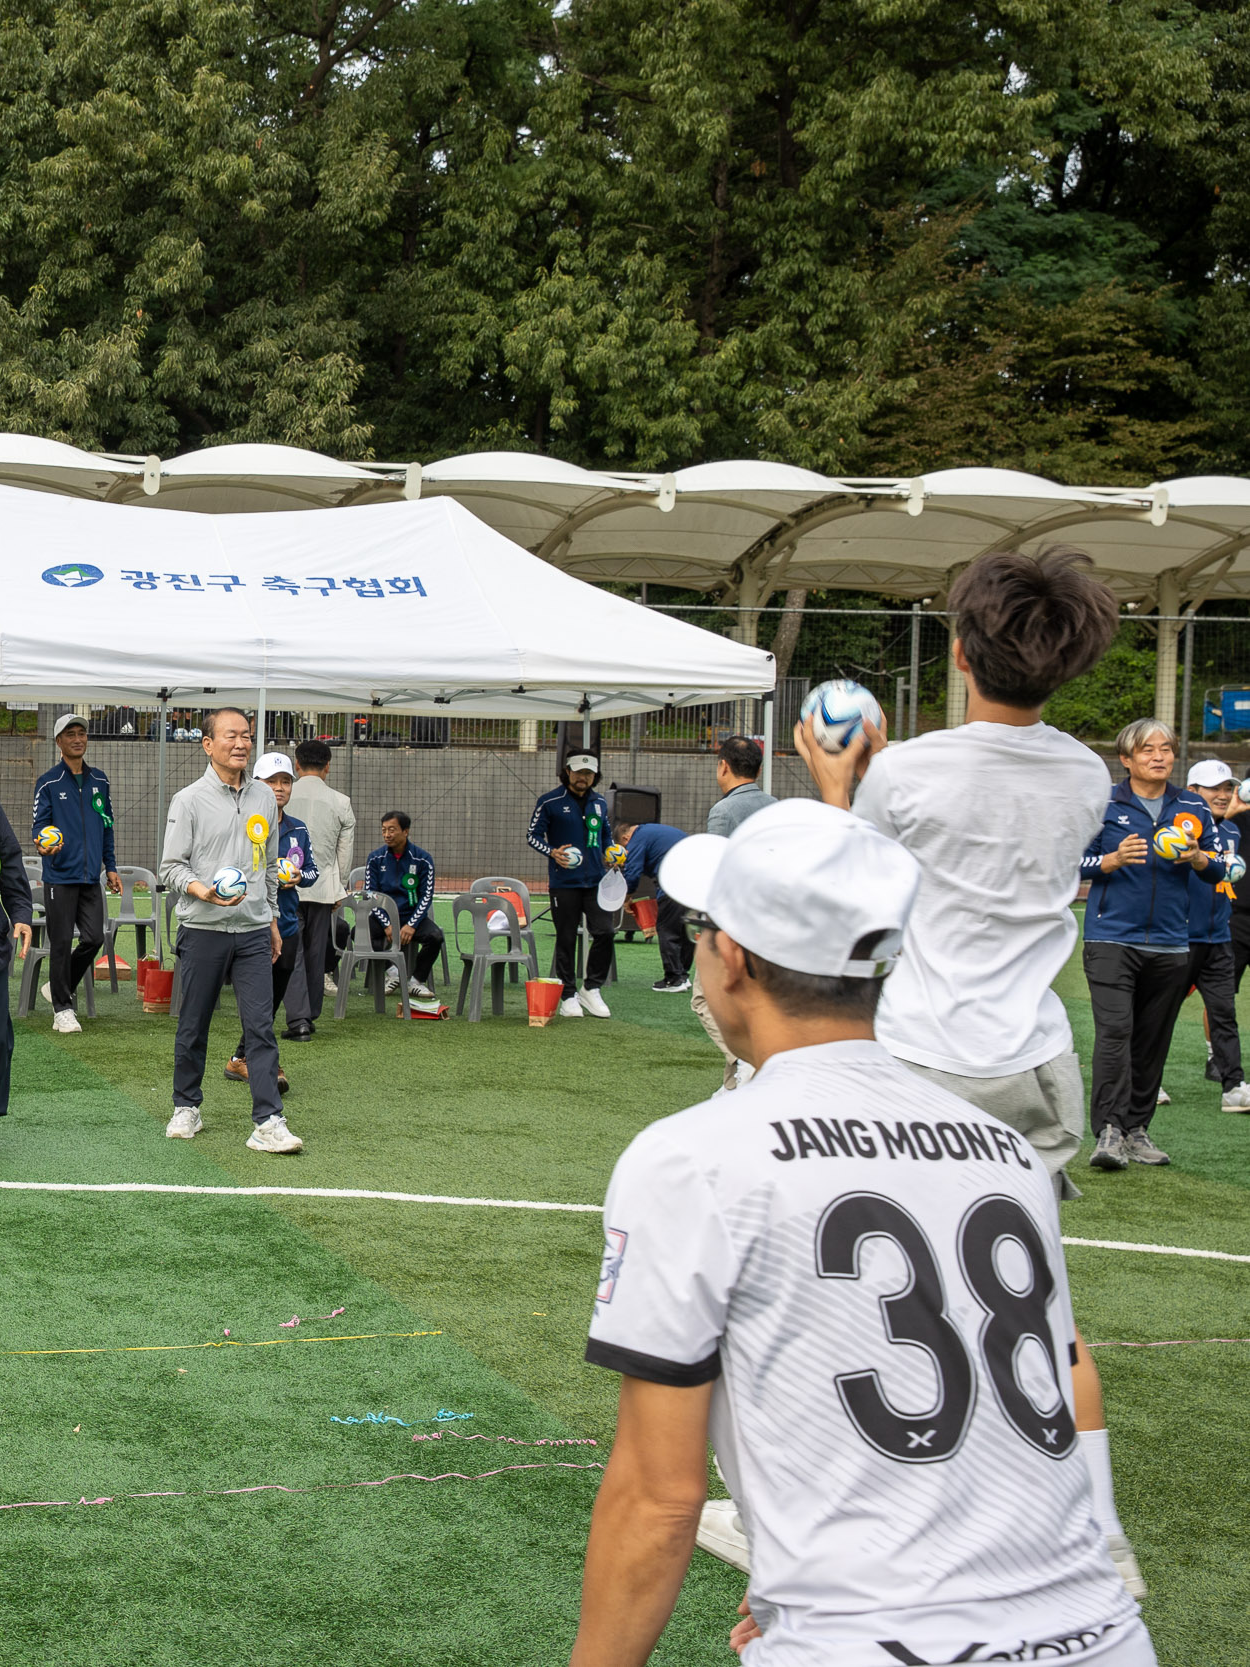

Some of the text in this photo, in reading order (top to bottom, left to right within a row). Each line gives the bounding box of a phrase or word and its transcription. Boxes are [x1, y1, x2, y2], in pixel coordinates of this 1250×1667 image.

[121, 570, 428, 597] 광진구 축구협회
[769, 1118, 1033, 1170] JANG MOON FC
[815, 1190, 1078, 1464] 38
